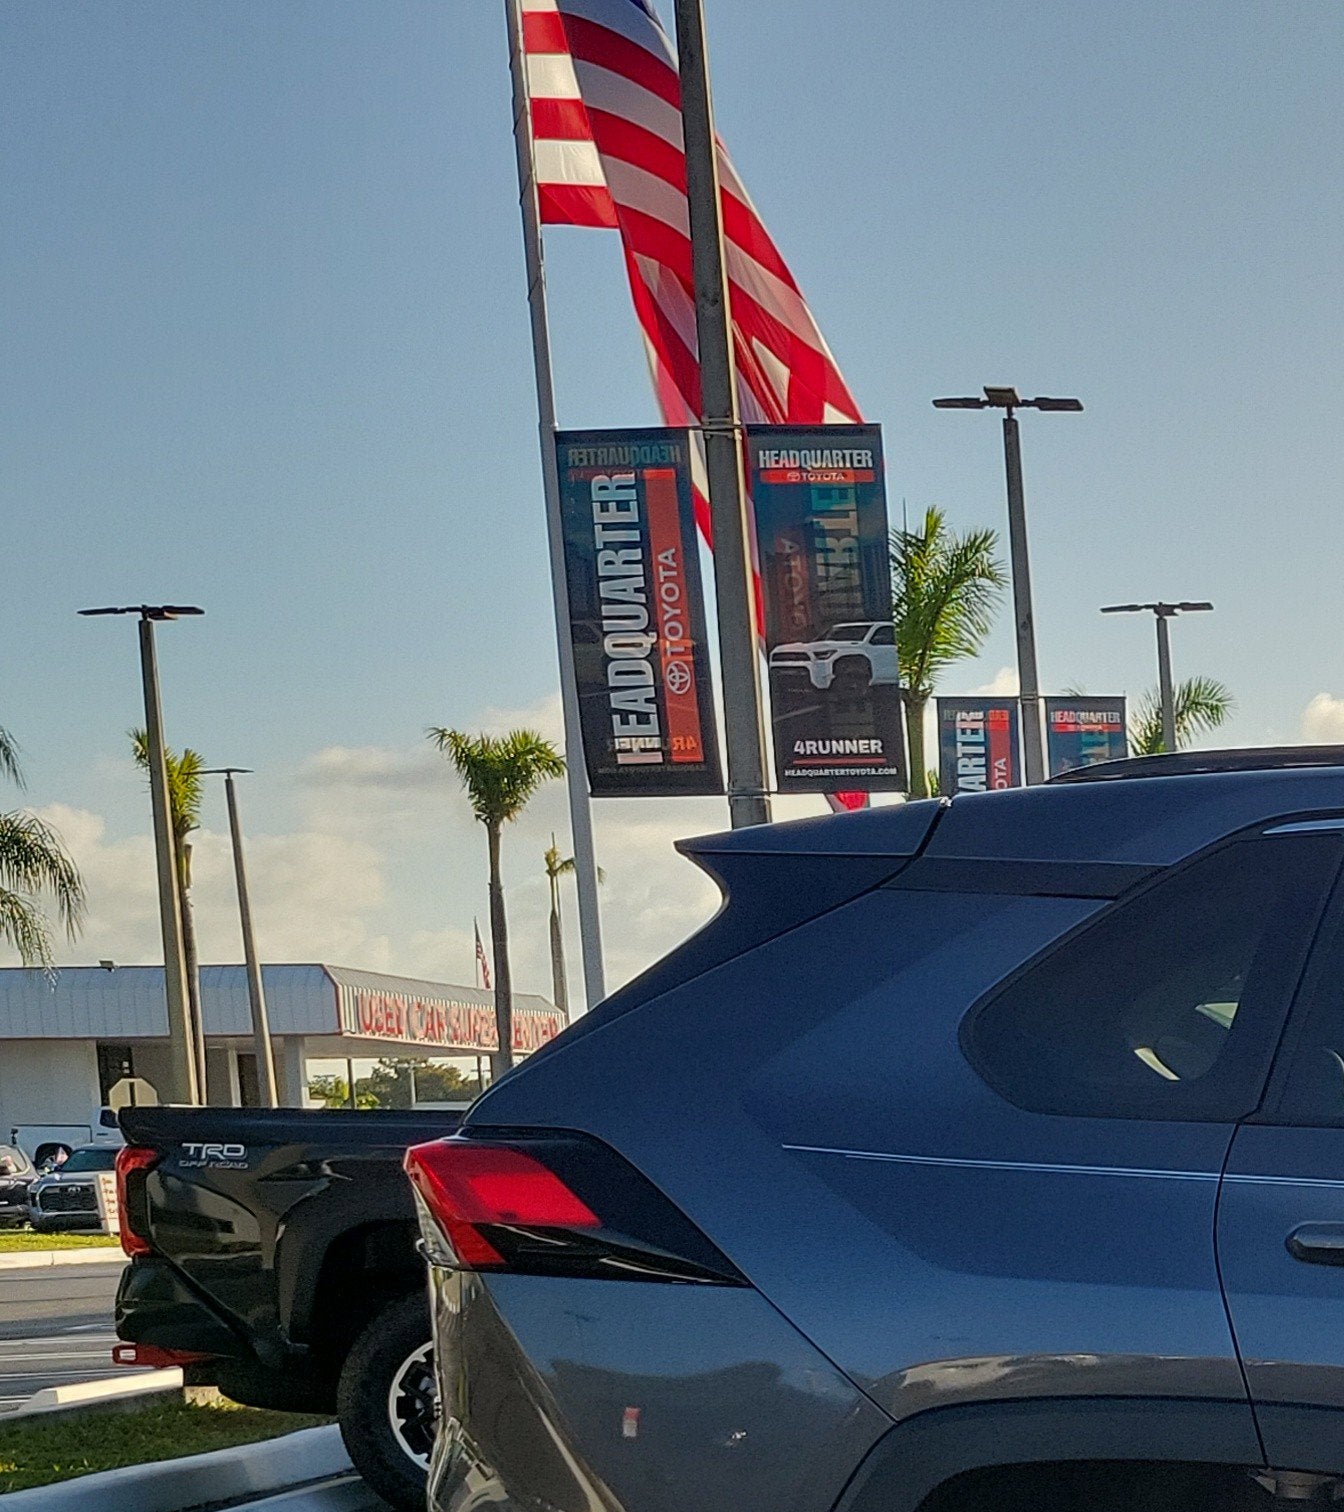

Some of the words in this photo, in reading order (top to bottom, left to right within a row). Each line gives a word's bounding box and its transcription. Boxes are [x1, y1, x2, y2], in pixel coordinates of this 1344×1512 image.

[758, 450, 873, 470] HEADQUARTER
[801, 472, 845, 481] TOYOTA
[658, 547, 686, 656] TOYOTA
[591, 473, 663, 764] HEADQUARTER
[1050, 711, 1121, 724] HEADQUARTER
[794, 740, 883, 755] 4RUNNER
[358, 992, 404, 1036] USED
[408, 1000, 447, 1041] CAR
[182, 1143, 246, 1160] TRD
